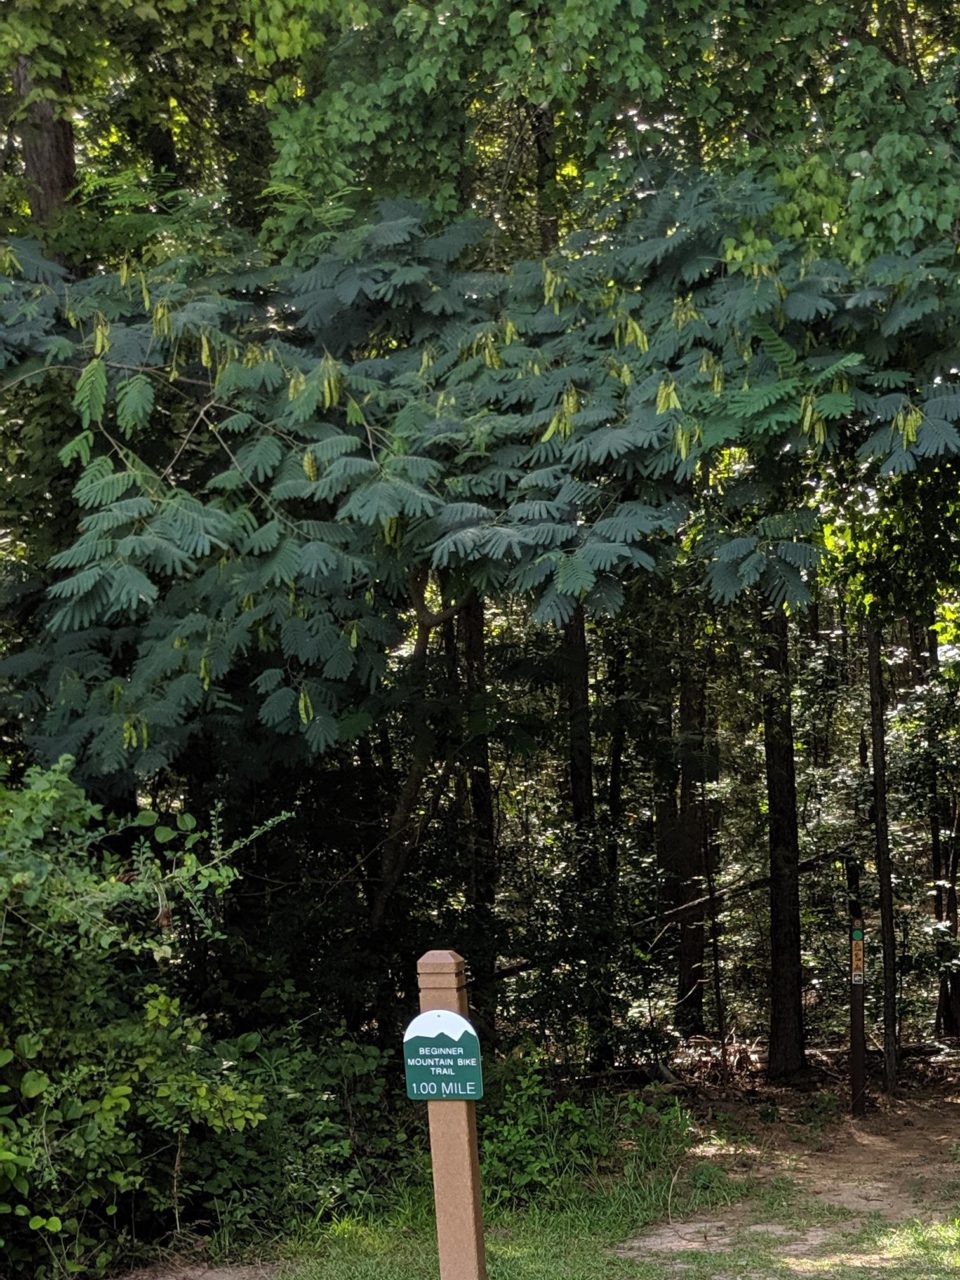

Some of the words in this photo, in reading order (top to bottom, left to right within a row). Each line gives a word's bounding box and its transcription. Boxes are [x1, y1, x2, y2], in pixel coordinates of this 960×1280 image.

[418, 1047, 463, 1055] BEGINNER
[407, 1058, 454, 1066] MOUNTAIN
[457, 1058, 477, 1066] BIKE
[430, 1067, 455, 1075] TRAIL
[412, 1082, 437, 1094] 1.00
[441, 1082, 476, 1094] MILE
